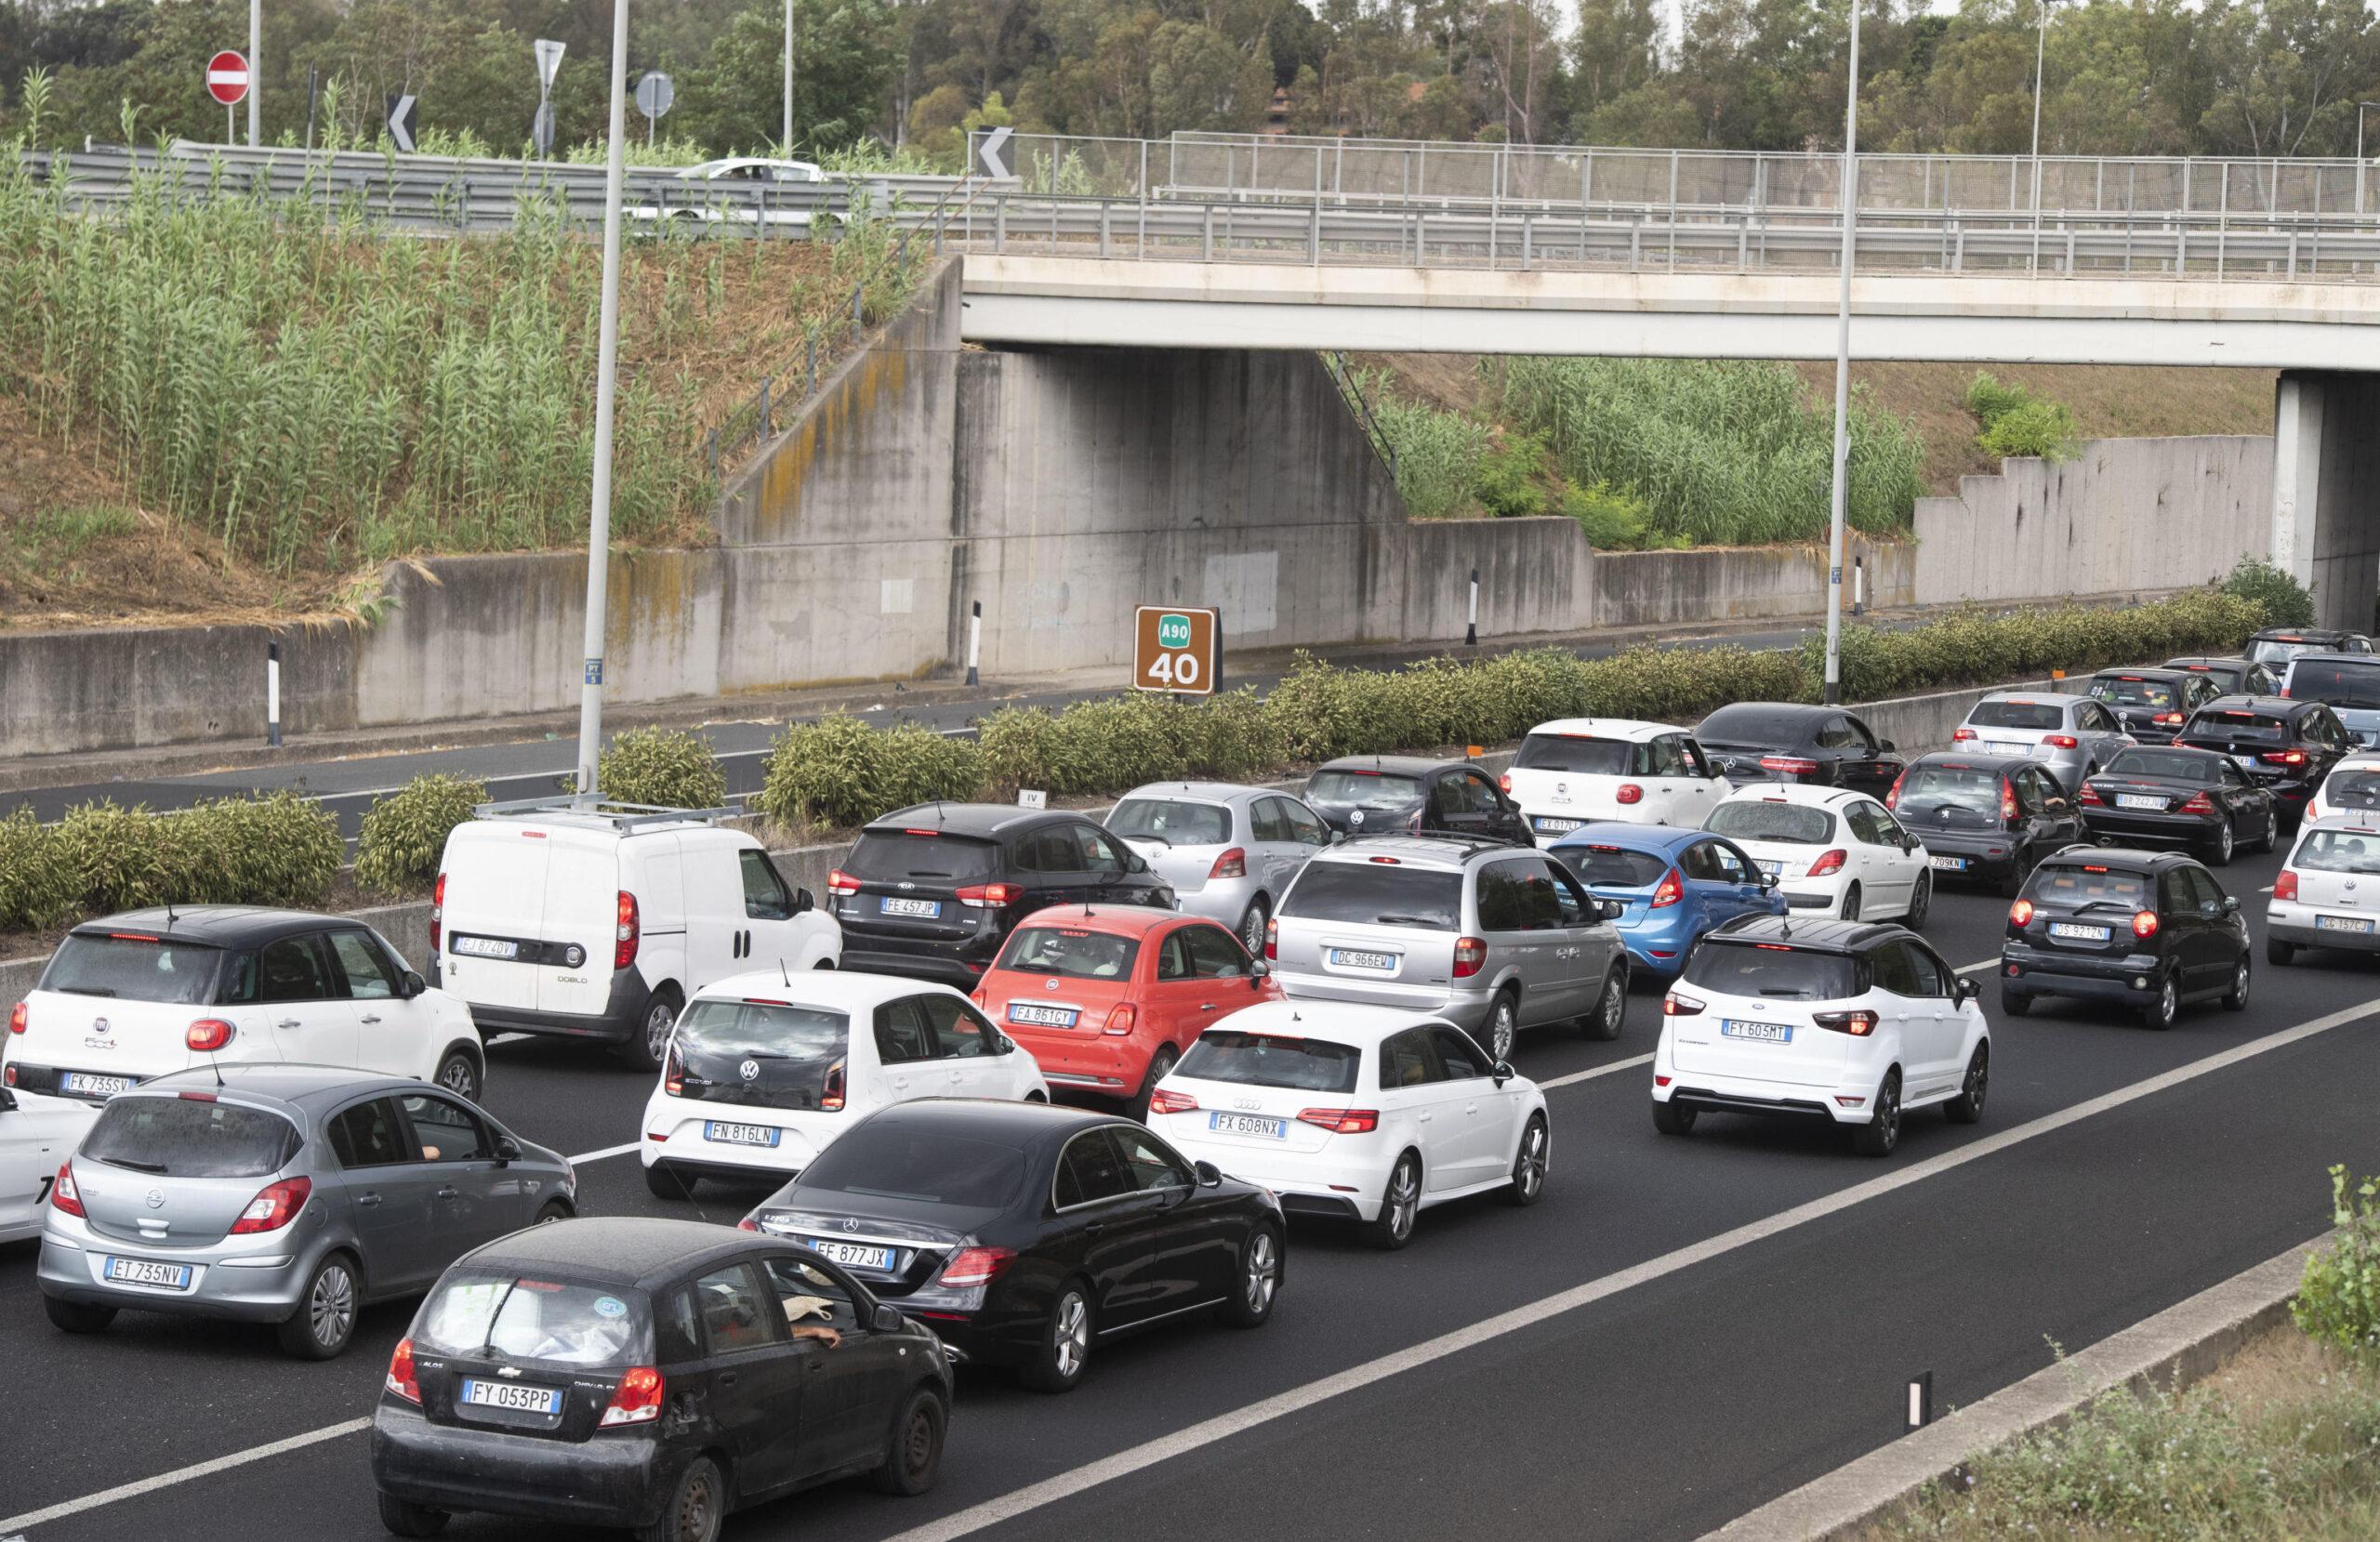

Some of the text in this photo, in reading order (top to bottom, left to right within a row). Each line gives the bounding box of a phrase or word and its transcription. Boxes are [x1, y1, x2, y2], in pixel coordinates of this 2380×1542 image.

[1161, 624, 1188, 639] A90
[1148, 652, 1199, 685] 40
[1541, 819, 1551, 829] EX
[1934, 857, 1960, 867] 709KN
[888, 900, 934, 915] FE 457JP
[2057, 924, 2103, 938] DS 921ZN
[2324, 917, 2366, 931] CG 157CJ
[463, 938, 509, 955] EJ 874DV
[1338, 952, 1387, 967] DC 966EW
[558, 976, 588, 984] DOBLO
[1016, 1008, 1069, 1023] FA 861GY
[1730, 1022, 1784, 1039] FY 605MT
[71, 1074, 128, 1092] FK 735SV
[1218, 1114, 1278, 1135] FX 608NX
[713, 1124, 772, 1143] FN 816LN
[840, 1245, 886, 1267] 877JX
[114, 1259, 180, 1284] ET 735NV
[473, 1383, 550, 1410] FY 053PP
